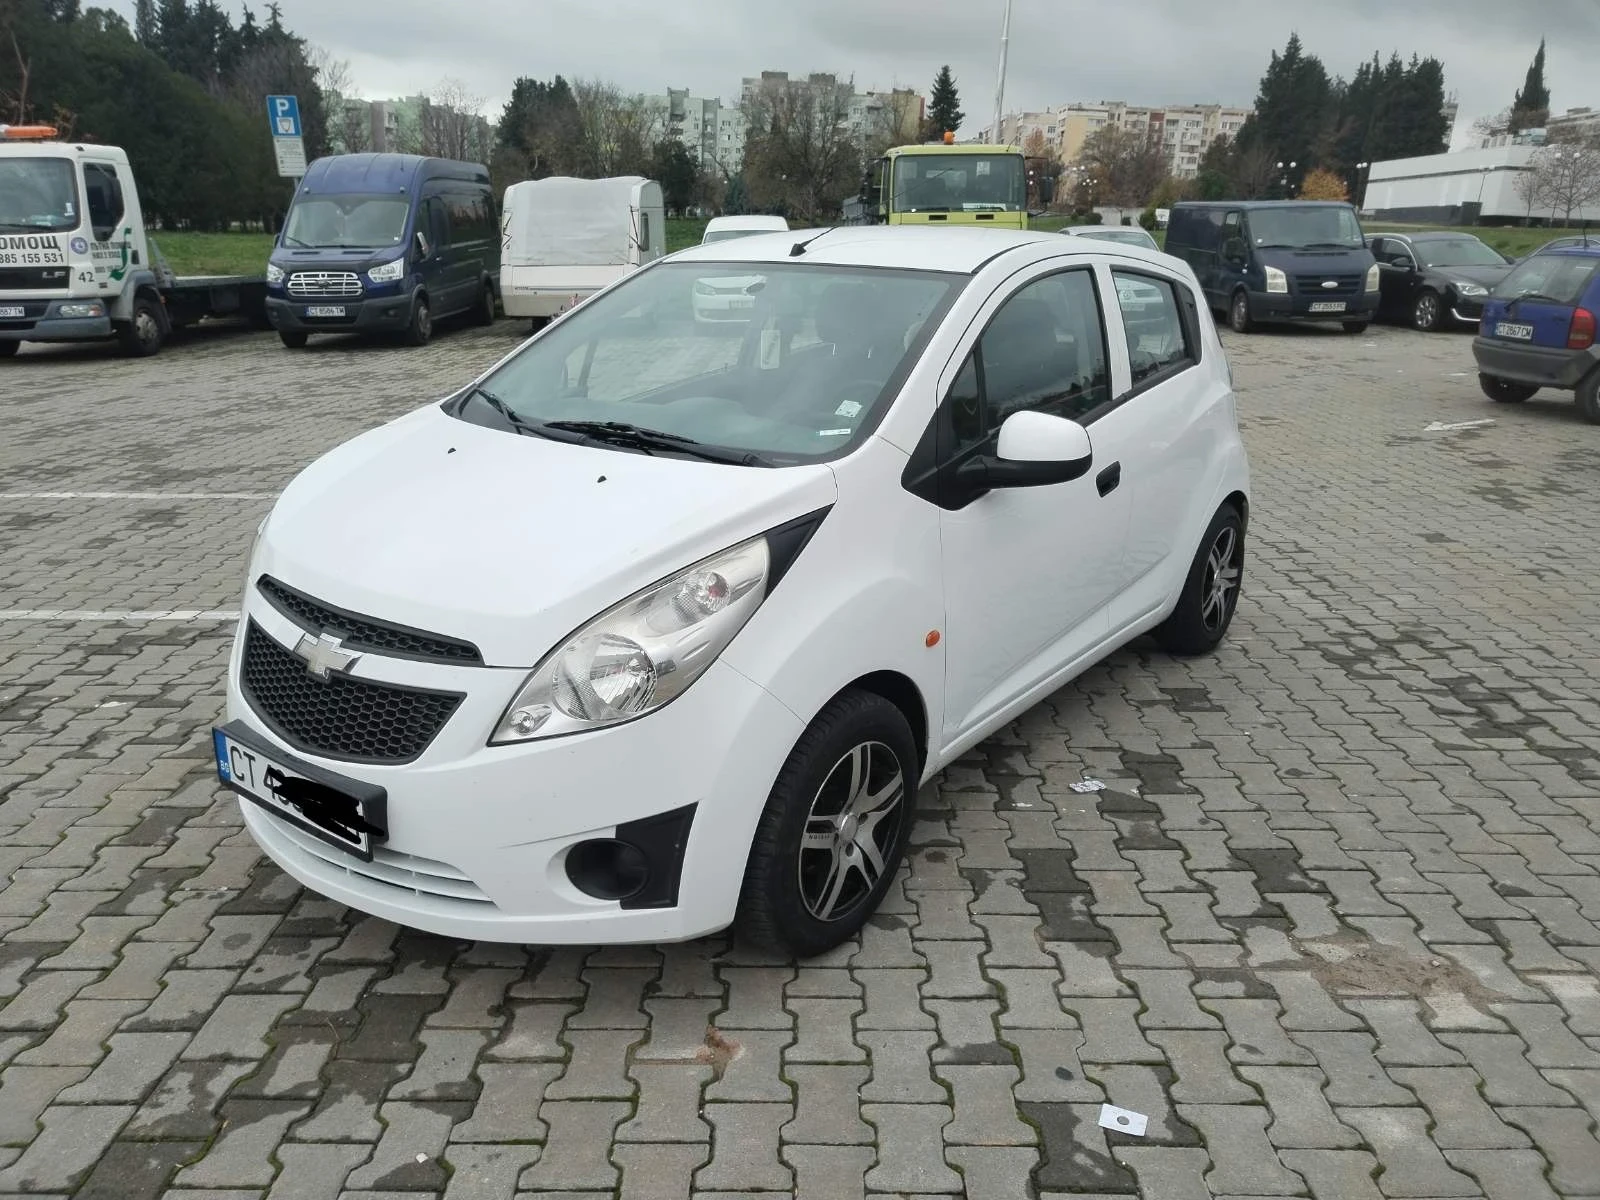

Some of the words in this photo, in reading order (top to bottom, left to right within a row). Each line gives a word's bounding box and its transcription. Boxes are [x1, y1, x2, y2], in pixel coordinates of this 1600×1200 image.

[275, 98, 289, 116] P
[21, 253, 41, 264] 155
[44, 252, 64, 263] 531
[78, 271, 95, 283] 42
[230, 745, 256, 789] CT
